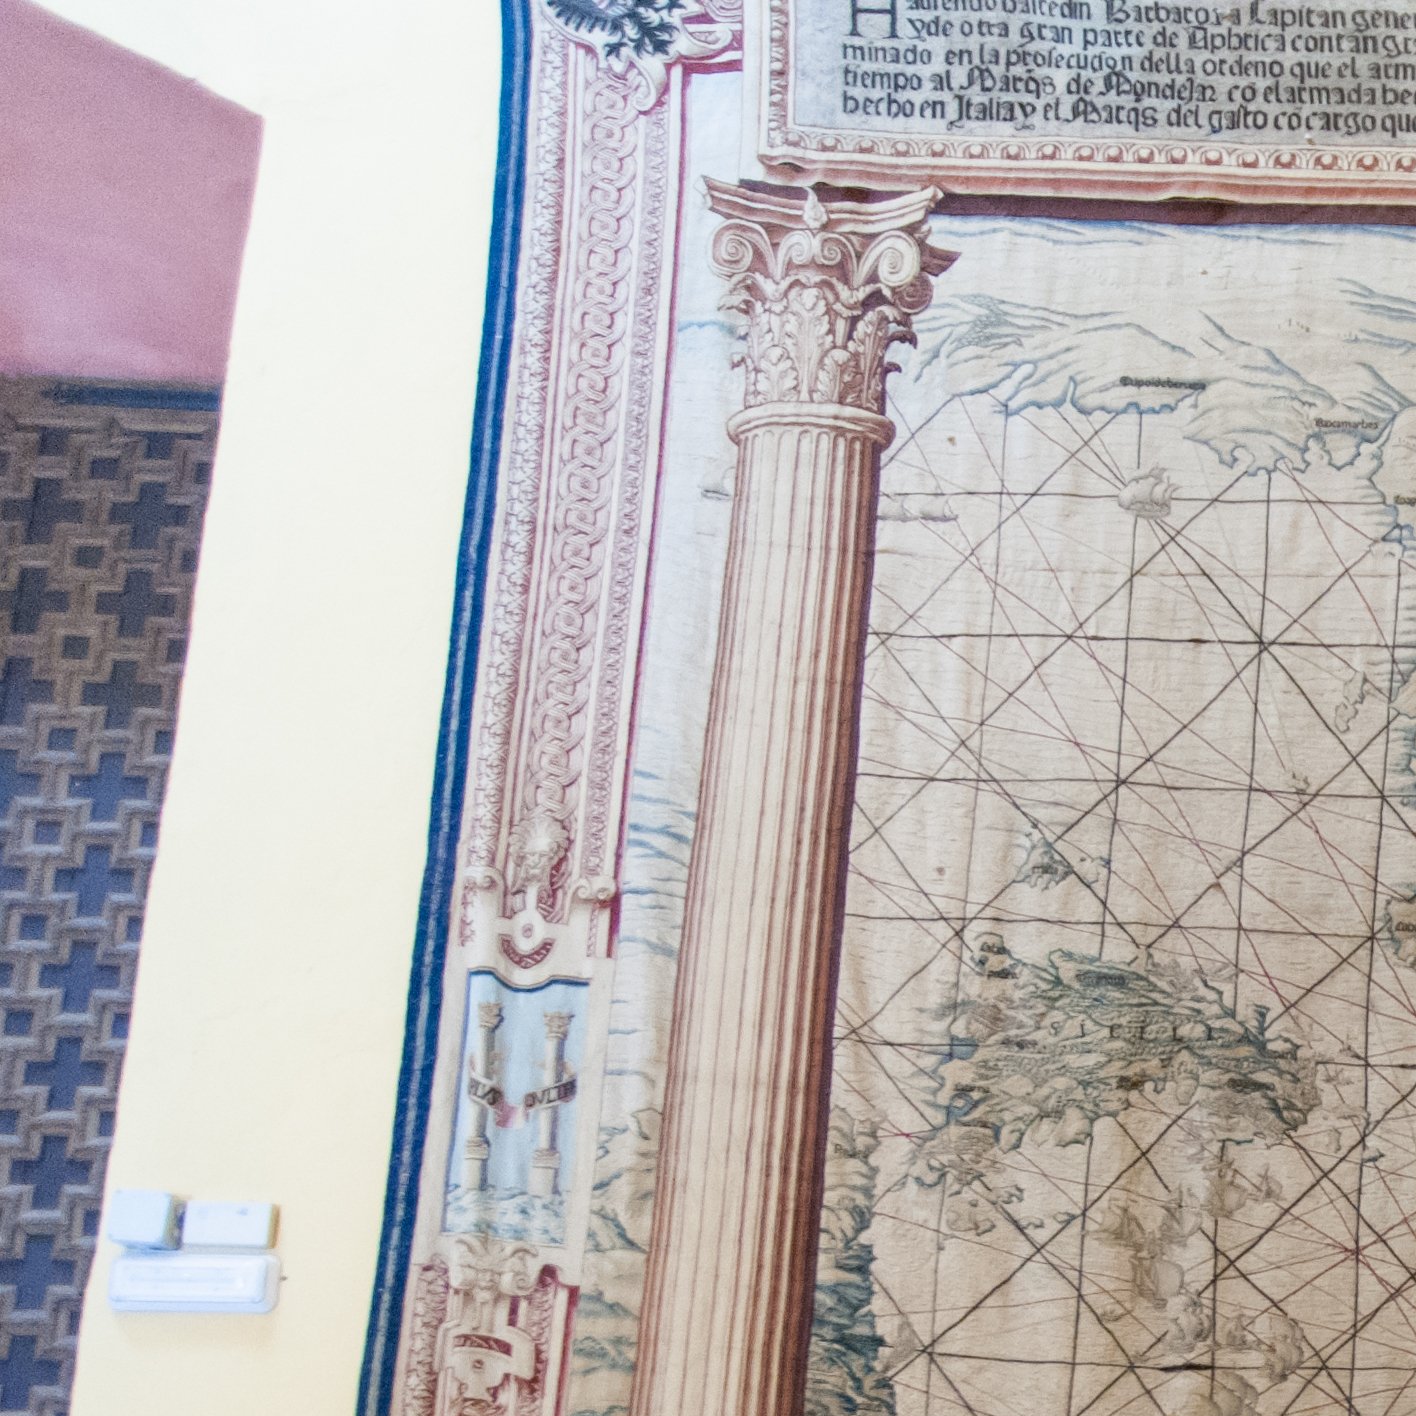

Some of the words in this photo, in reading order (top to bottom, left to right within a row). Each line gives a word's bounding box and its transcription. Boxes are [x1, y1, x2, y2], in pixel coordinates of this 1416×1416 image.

[1152, 24, 1178, 47] de
[945, 48, 973, 65] en
[979, 43, 1000, 66] la
[1290, 61, 1333, 84] que
[1337, 57, 1358, 79] el
[1067, 73, 1094, 97] de
[920, 101, 945, 118] en
